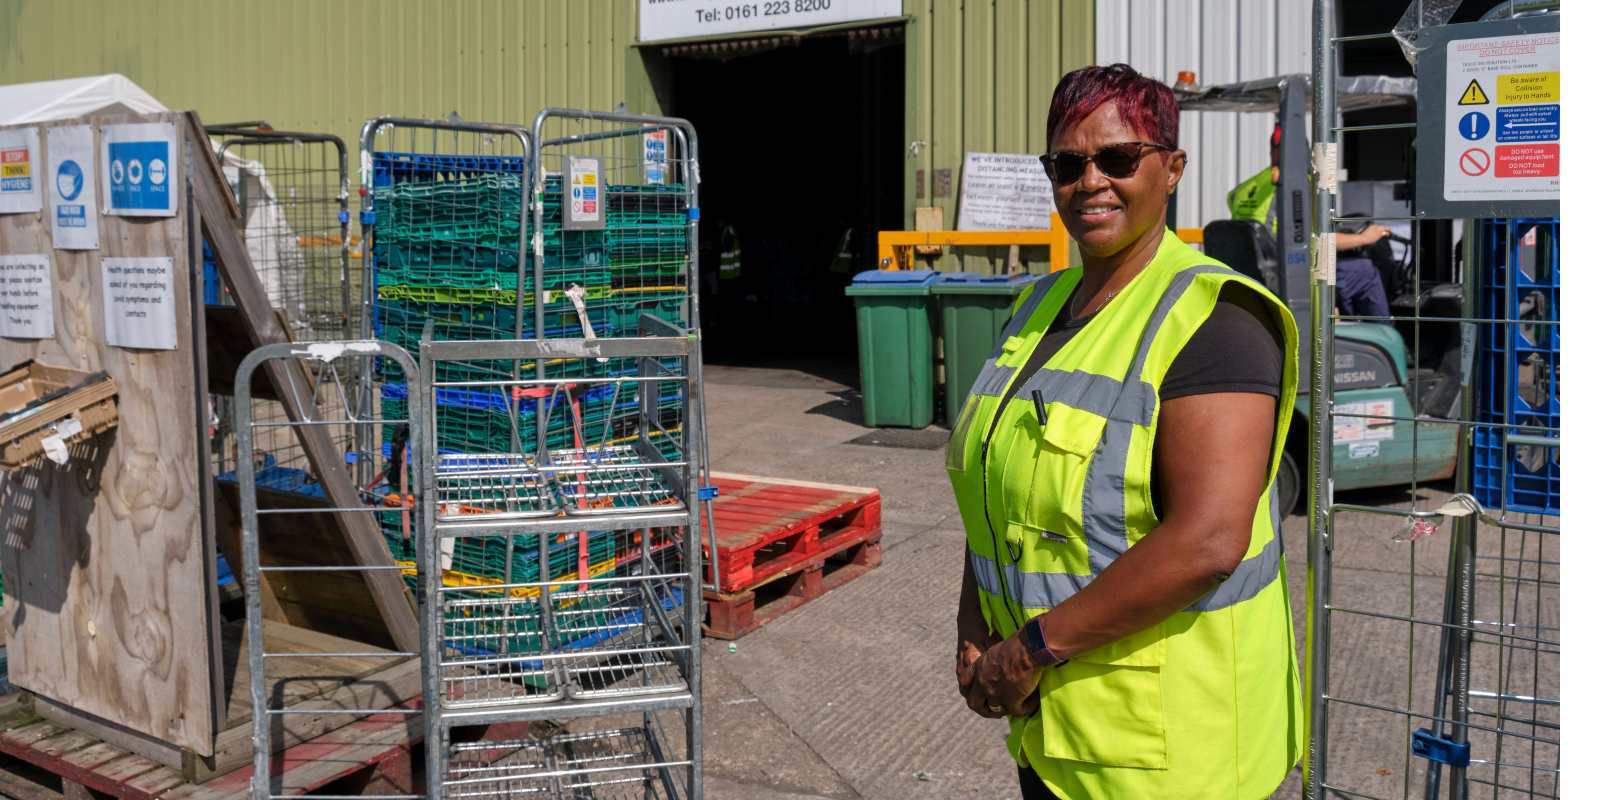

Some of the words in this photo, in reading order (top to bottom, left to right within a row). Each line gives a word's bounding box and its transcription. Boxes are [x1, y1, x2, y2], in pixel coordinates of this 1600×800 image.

[696, 9, 721, 23] Tel:
[725, 4, 758, 20] 0161
[764, 2, 791, 16] 223
[794, 0, 831, 13] 8200
[994, 157, 1038, 165] INTRODUCED
[977, 166, 1018, 174] DISTANCING
[129, 282, 138, 290] you
[139, 280, 167, 292] regarding
[23, 289, 39, 297] before
[126, 296, 150, 305] symptoms
[125, 310, 147, 318] contacts
[1334, 370, 1376, 383] NISSAN
